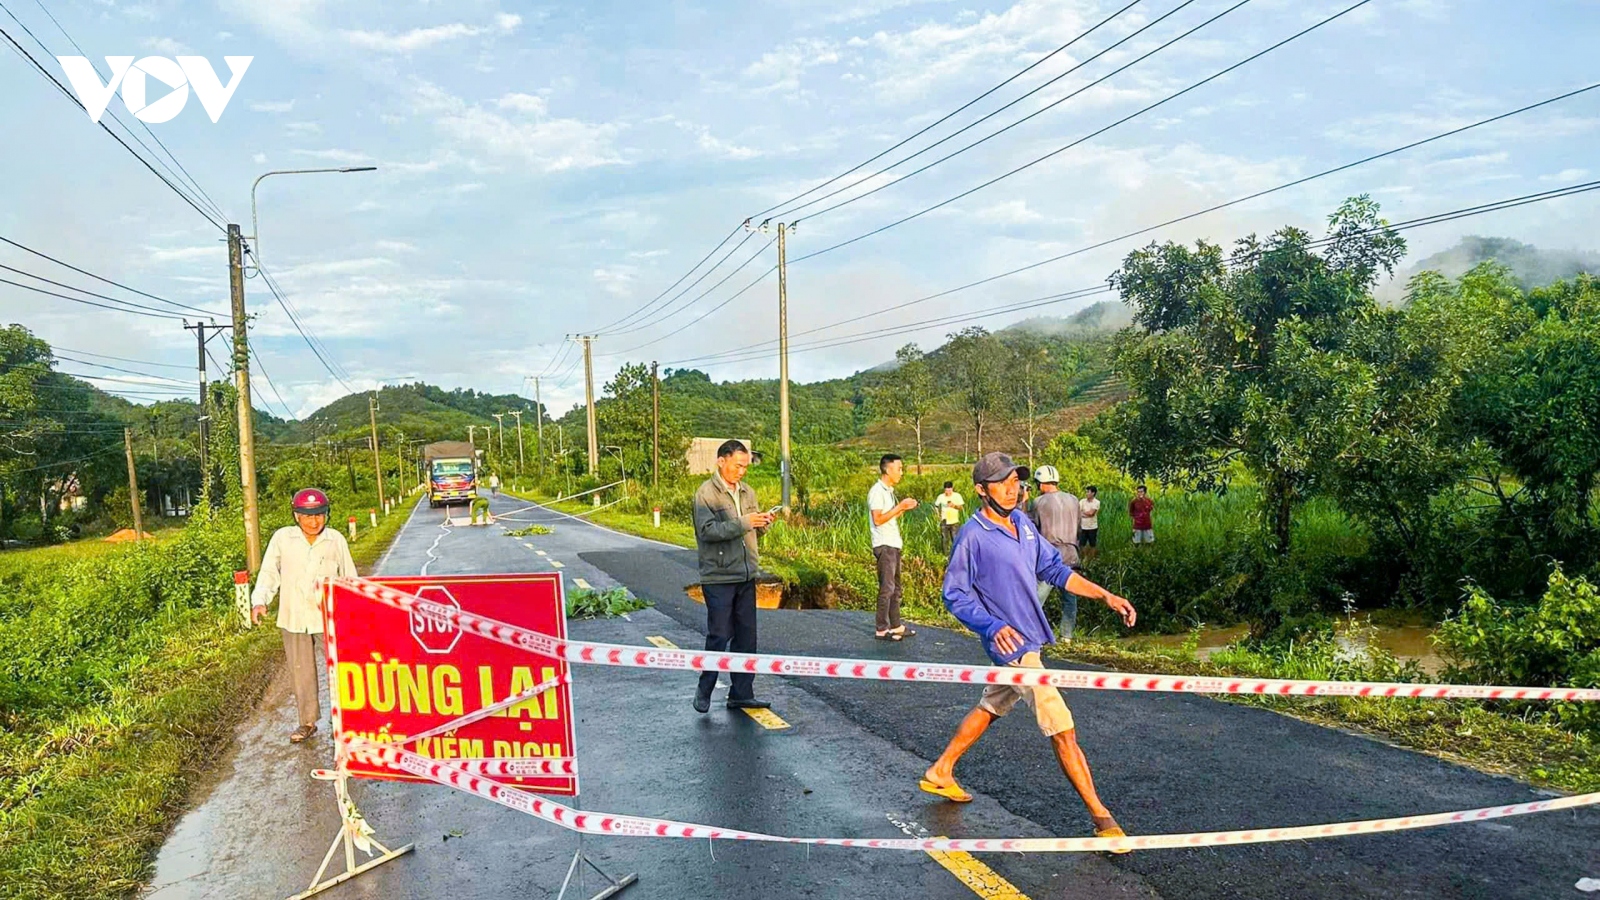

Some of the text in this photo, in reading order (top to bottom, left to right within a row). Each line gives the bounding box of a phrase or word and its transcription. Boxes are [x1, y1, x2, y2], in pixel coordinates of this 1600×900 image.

[337, 652, 558, 731] DỪNG LẠI
[416, 729, 484, 760] KIỂM
